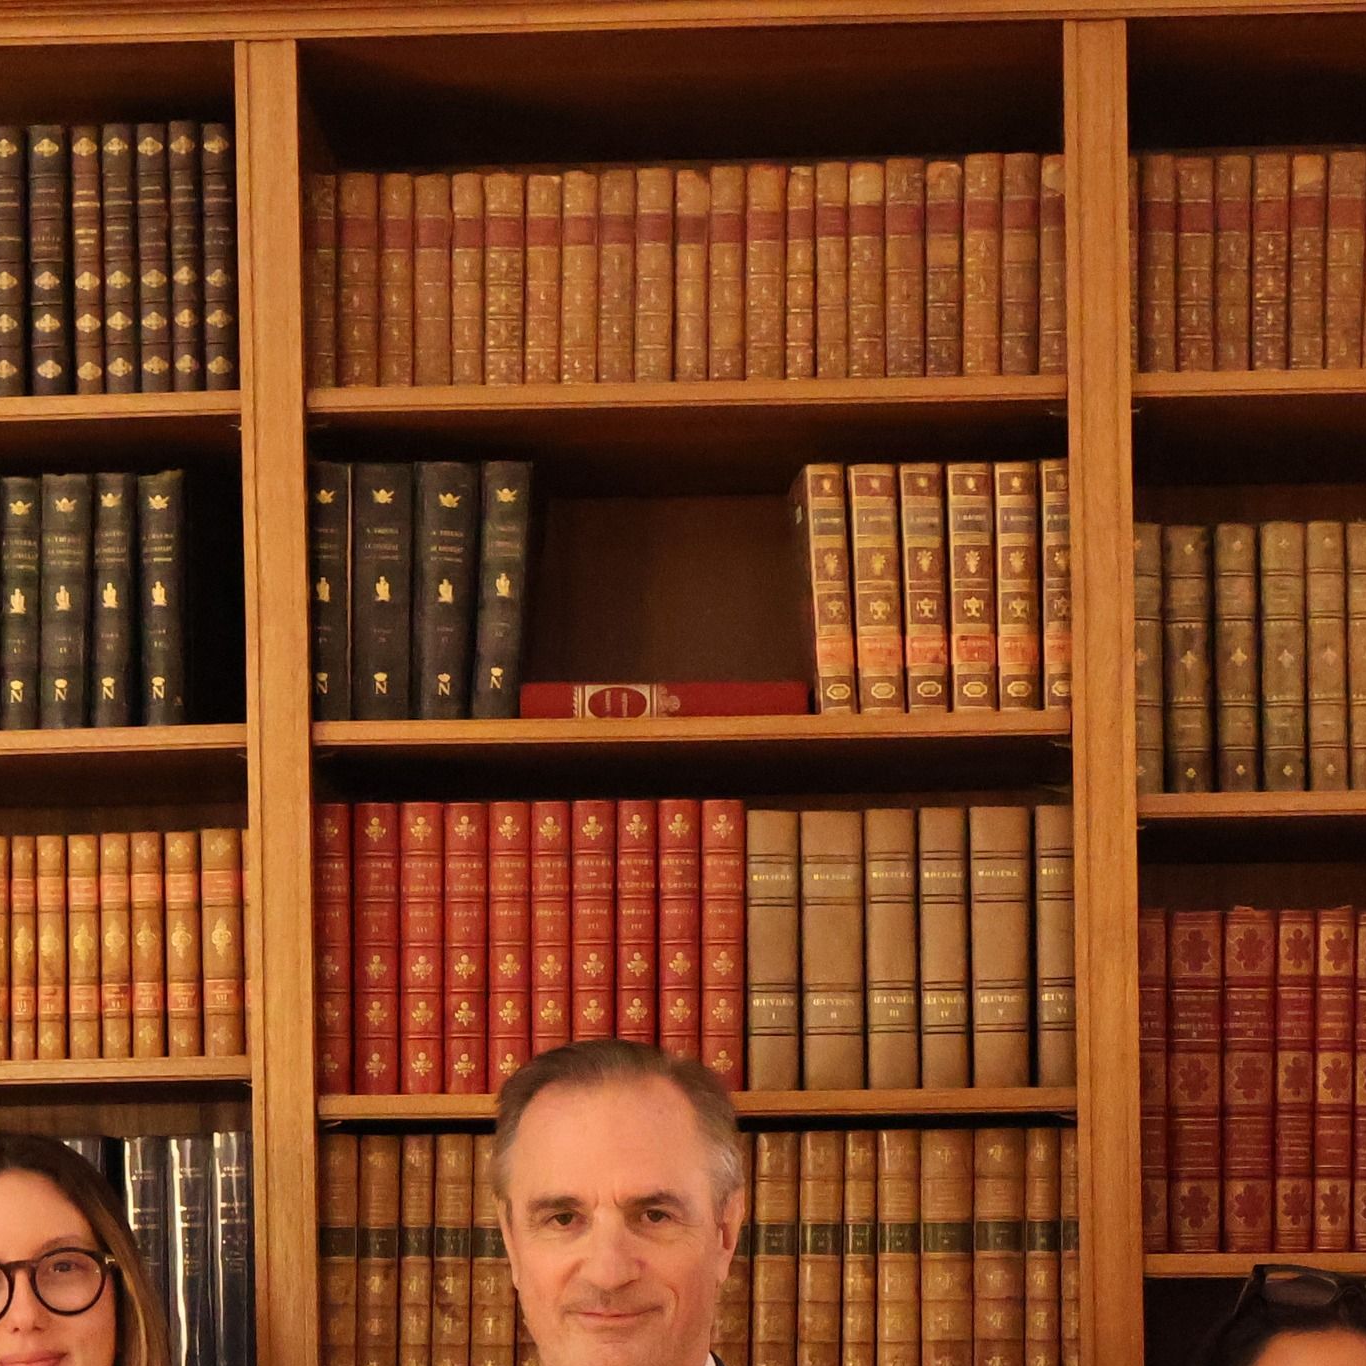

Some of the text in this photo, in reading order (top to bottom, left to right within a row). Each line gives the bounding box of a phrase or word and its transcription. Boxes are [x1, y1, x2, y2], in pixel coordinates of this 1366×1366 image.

[316, 681, 327, 694] N
[375, 681, 387, 695] N
[490, 676, 502, 688] N
[55, 688, 67, 702] N
[102, 686, 114, 700] N
[152, 686, 164, 699] N
[438, 682, 450, 696] N
[10, 690, 23, 703] N
